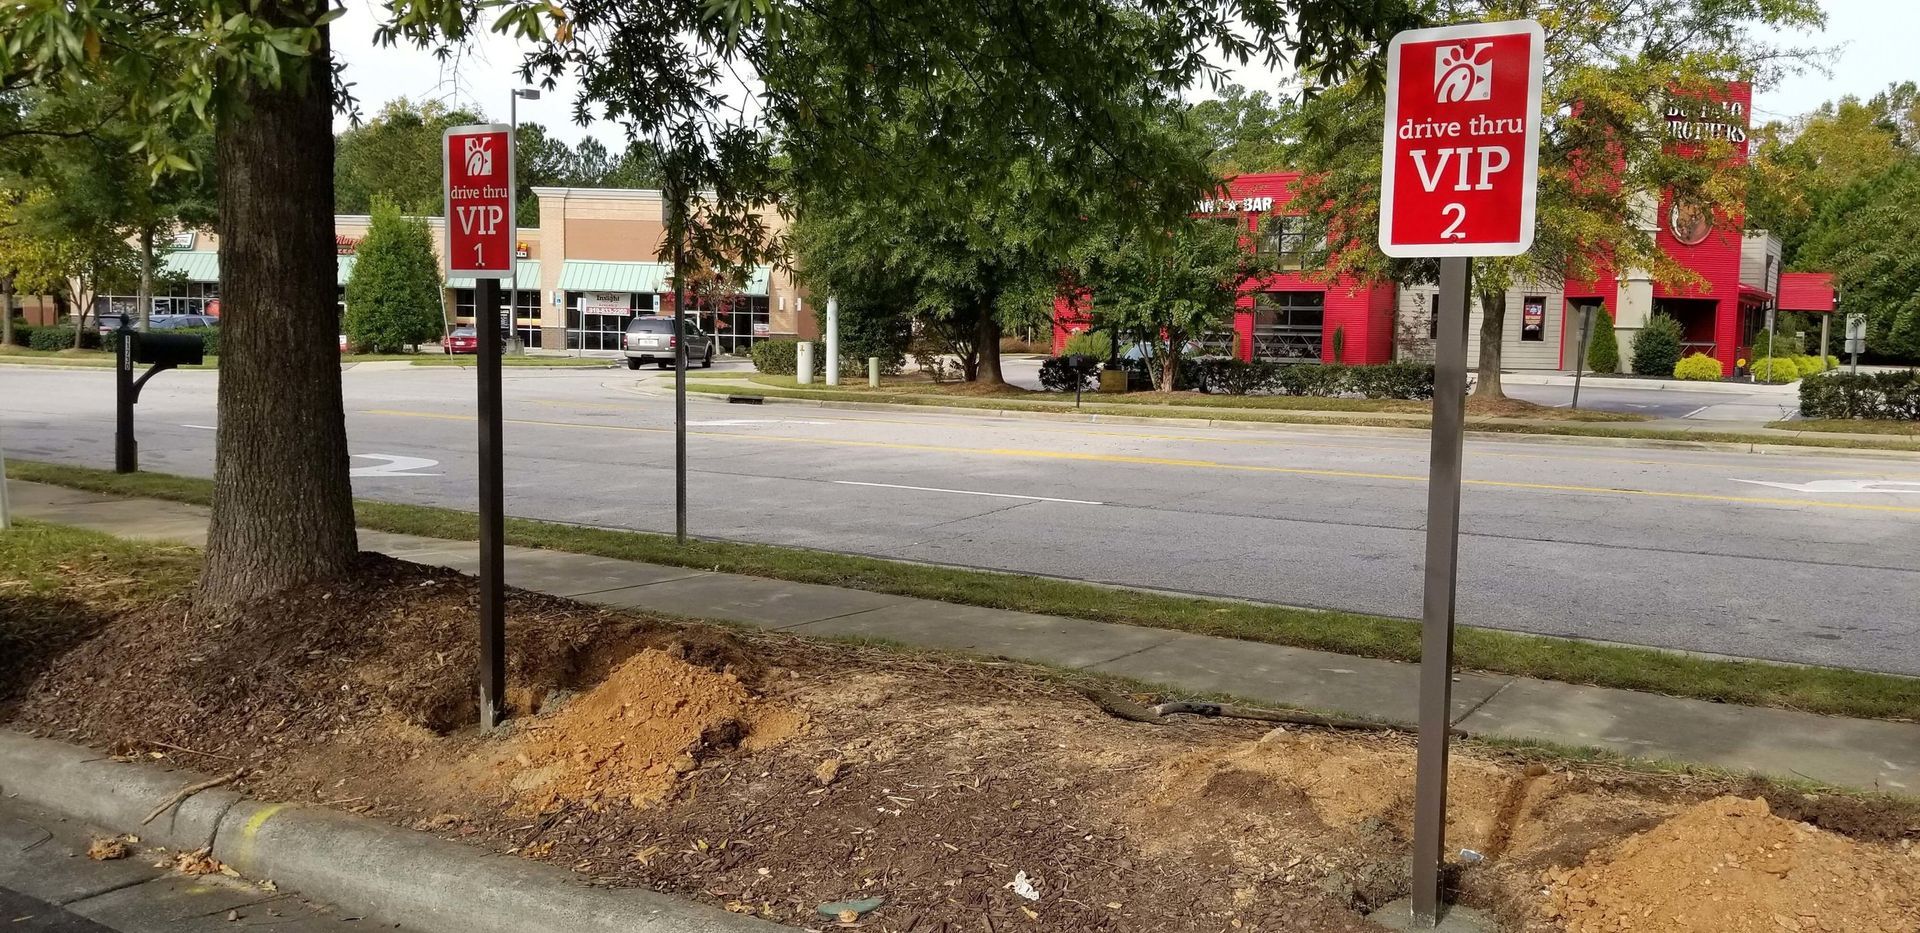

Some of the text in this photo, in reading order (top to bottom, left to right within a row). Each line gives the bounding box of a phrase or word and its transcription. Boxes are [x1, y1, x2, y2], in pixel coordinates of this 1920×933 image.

[1399, 114, 1523, 140] drive thru
[1409, 146, 1511, 192] VIP
[450, 185, 508, 199] drive thru
[1243, 197, 1273, 212] BAR
[456, 205, 504, 235] VIP
[1440, 202, 1466, 239] 2
[473, 242, 486, 267] 1
